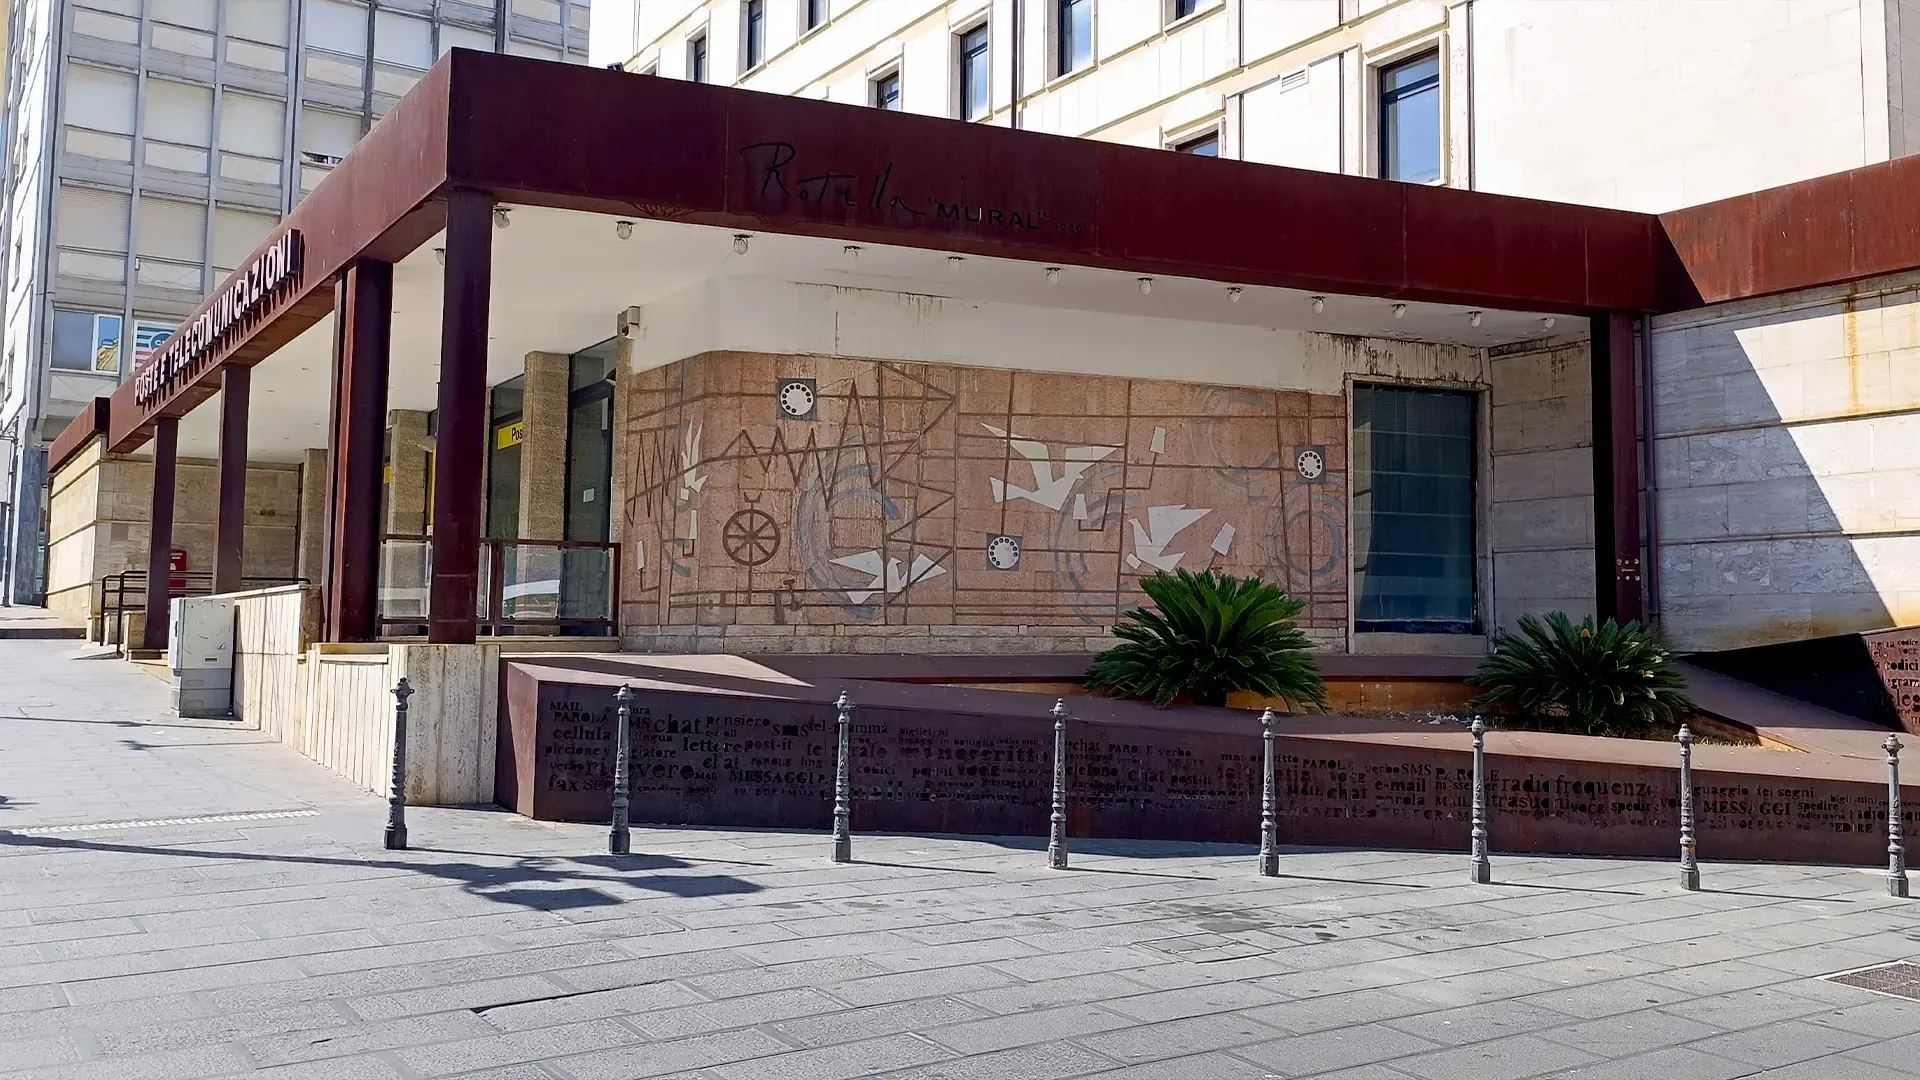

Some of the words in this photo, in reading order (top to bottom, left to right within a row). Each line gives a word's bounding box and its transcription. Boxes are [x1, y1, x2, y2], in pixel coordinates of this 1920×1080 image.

[929, 196, 1048, 230] "MURAL"
[1052, 222, 1083, 235] 1949
[135, 358, 161, 406] POSTE
[160, 352, 169, 384] E
[168, 228, 300, 378] TELECOMUNICAZIONI
[550, 701, 582, 711] MAIL
[554, 712, 609, 723] PAROLA
[653, 713, 701, 734] chat
[772, 723, 808, 737] sms
[545, 744, 600, 756] piccione
[745, 738, 792, 752] post-it
[1108, 744, 1154, 754] PAROE
[1158, 747, 1192, 757] verbo
[1365, 763, 1400, 774] verbo
[1401, 763, 1432, 776] SMS
[548, 774, 579, 792] fax
[729, 770, 814, 784] MESSAGGI
[1330, 772, 1366, 783] VOCE
[1375, 778, 1426, 792] e-mail
[1287, 784, 1323, 796] MAIL
[1327, 783, 1367, 800] chat
[1777, 787, 1815, 799] segni
